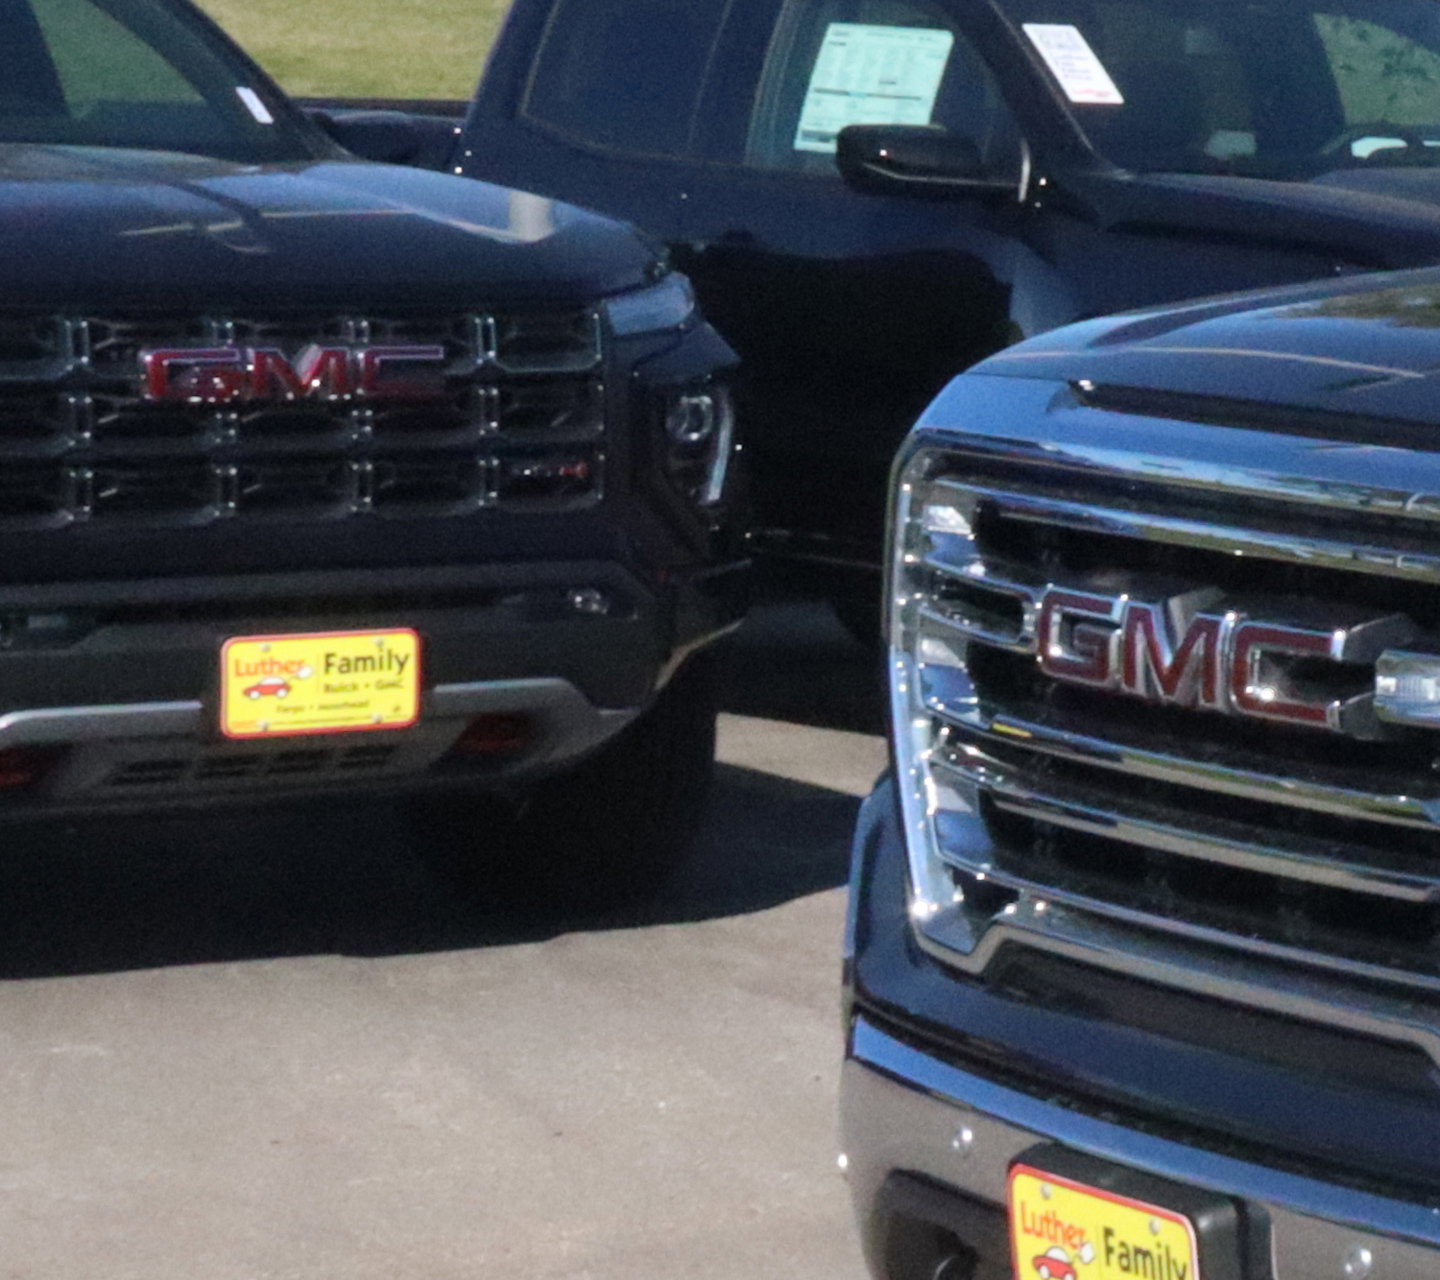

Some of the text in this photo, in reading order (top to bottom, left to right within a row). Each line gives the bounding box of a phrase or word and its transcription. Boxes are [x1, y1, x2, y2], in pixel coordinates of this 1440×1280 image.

[137, 345, 444, 402] GMC
[234, 658, 305, 678] Luther
[324, 648, 410, 676] Family
[1037, 584, 1347, 729] GMC
[1021, 1200, 1086, 1251] Luther
